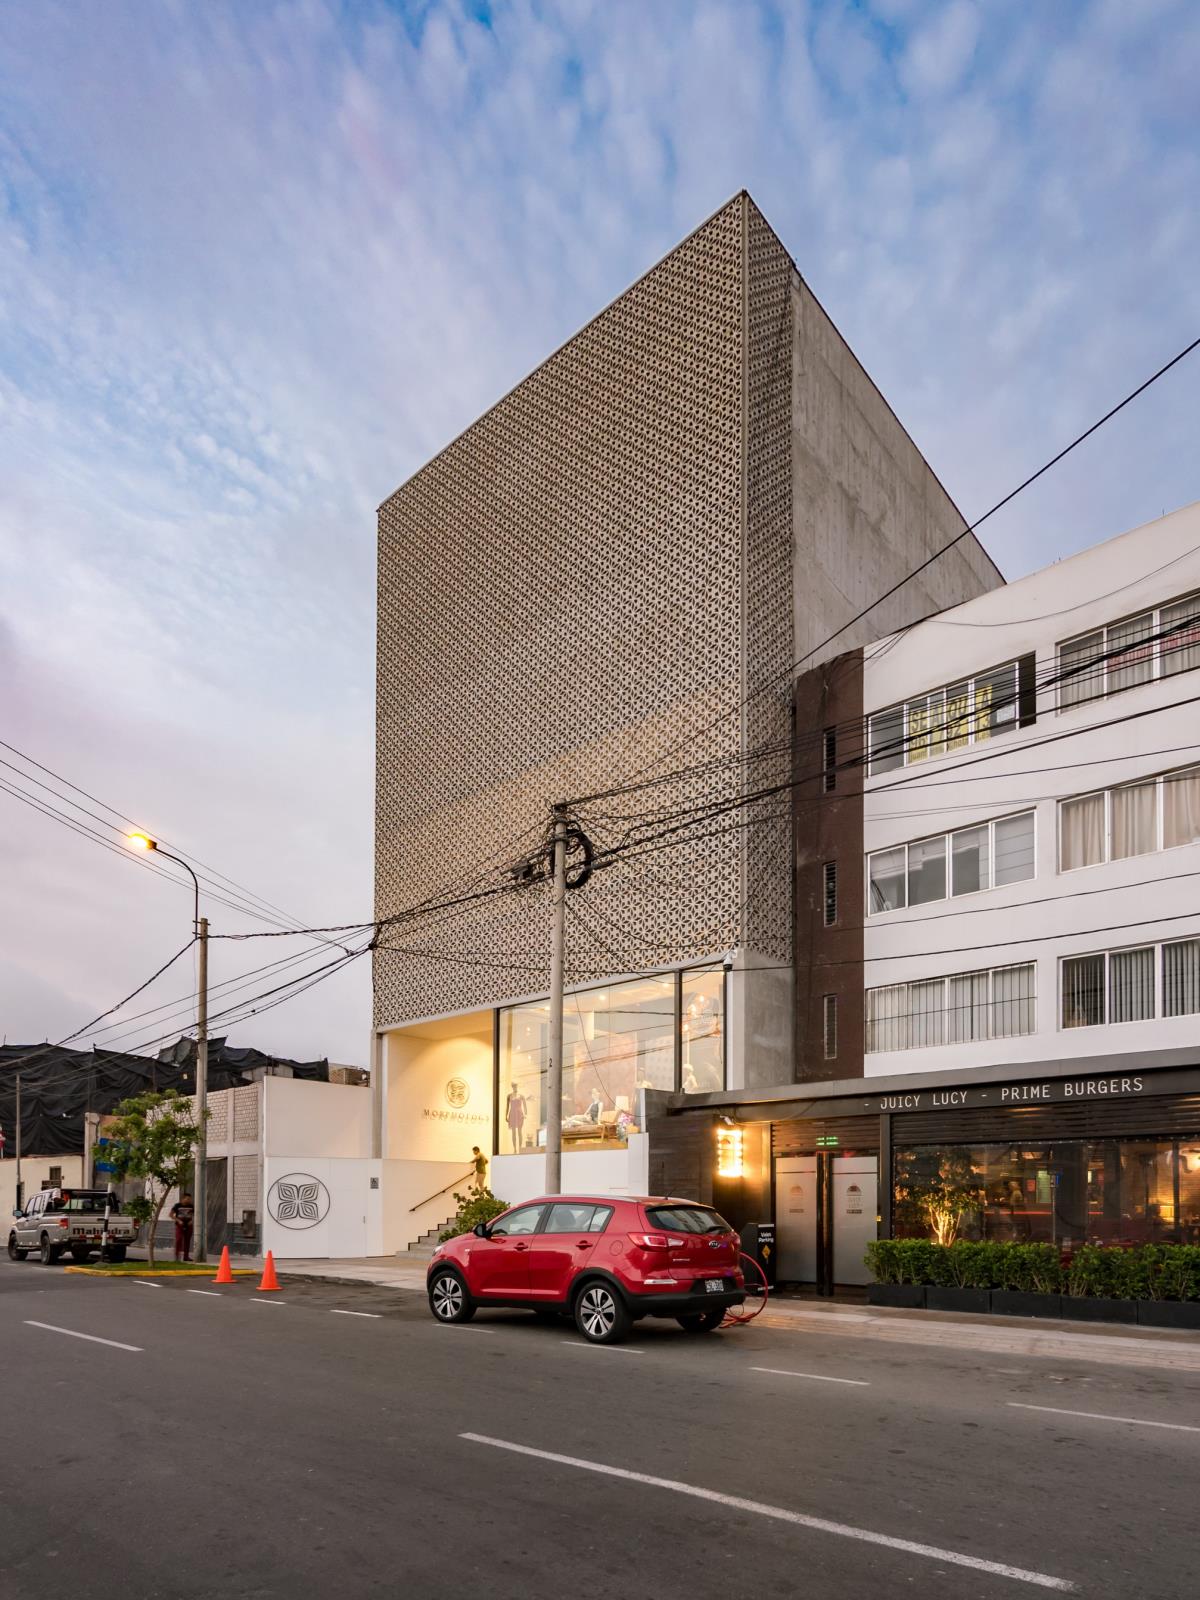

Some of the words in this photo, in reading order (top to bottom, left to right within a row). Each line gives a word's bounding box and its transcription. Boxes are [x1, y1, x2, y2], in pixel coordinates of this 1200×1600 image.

[880, 1095, 921, 1110] JUICY
[932, 1091, 968, 1106] LUCY
[1001, 1085, 1051, 1101] PRIME
[1064, 1077, 1144, 1096] BURGERS
